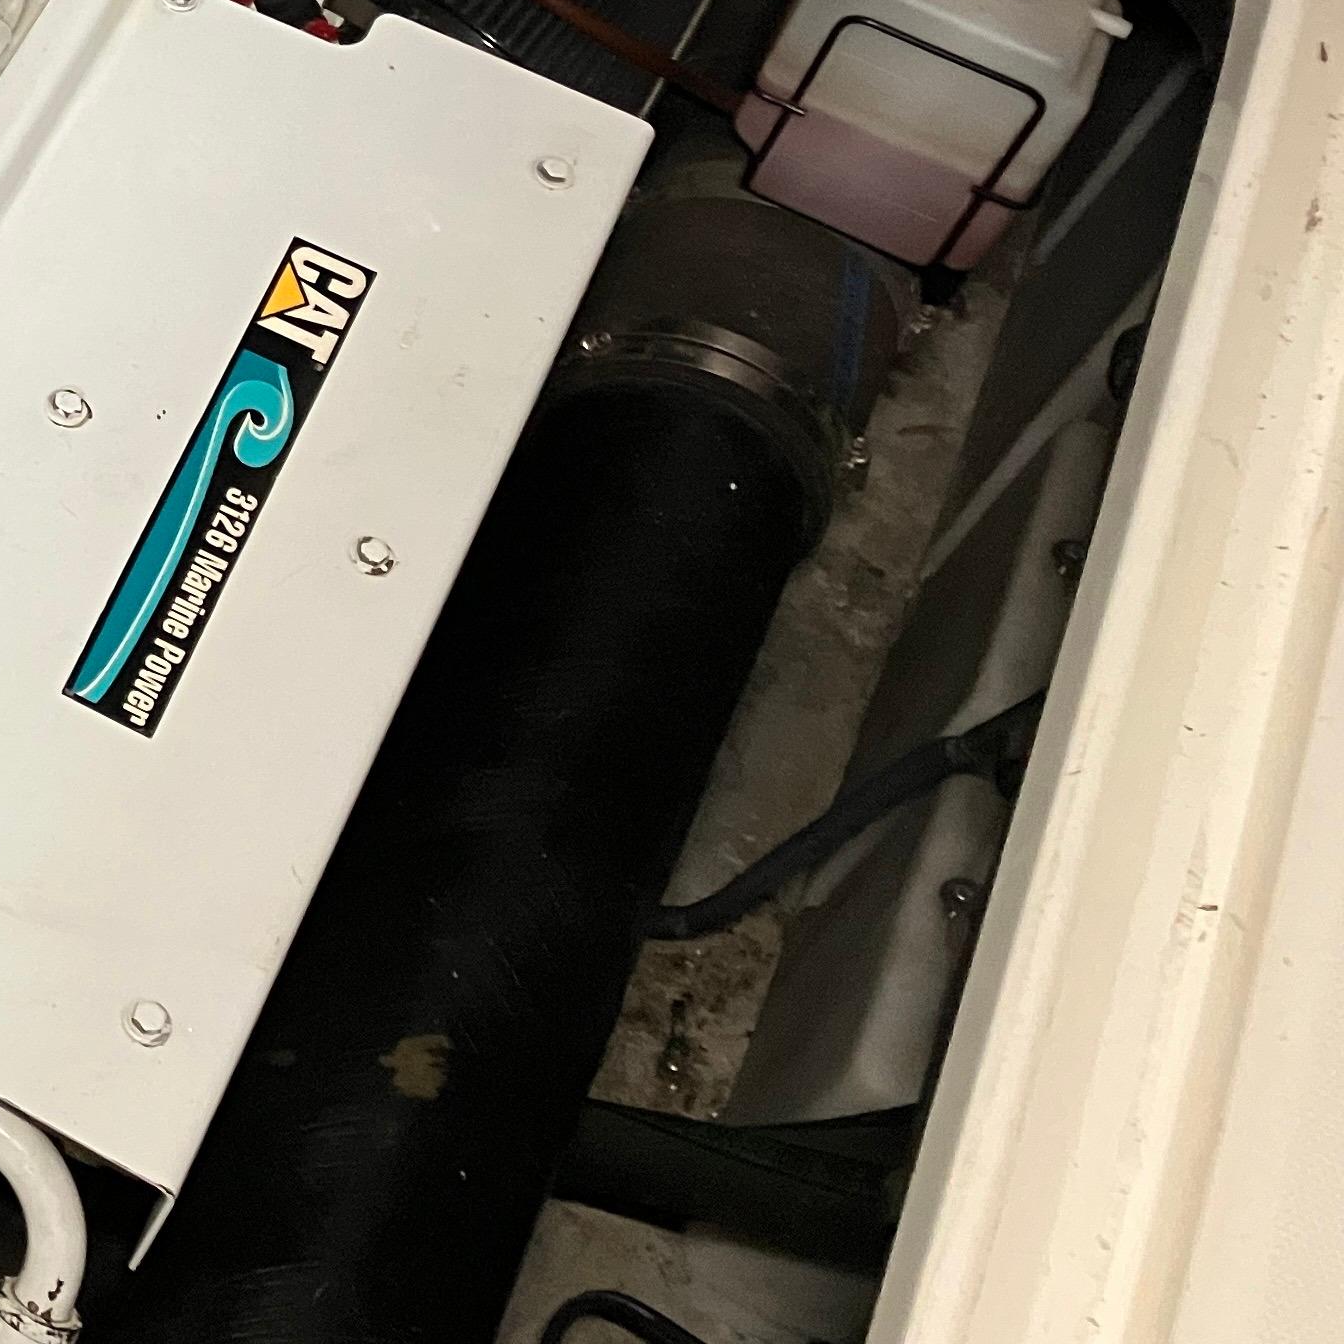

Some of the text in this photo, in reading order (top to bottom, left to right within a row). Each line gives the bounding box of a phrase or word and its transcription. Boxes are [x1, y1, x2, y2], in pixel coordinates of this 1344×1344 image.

[258, 245, 367, 365] CAT
[123, 487, 258, 727] 3126 Marine Power
